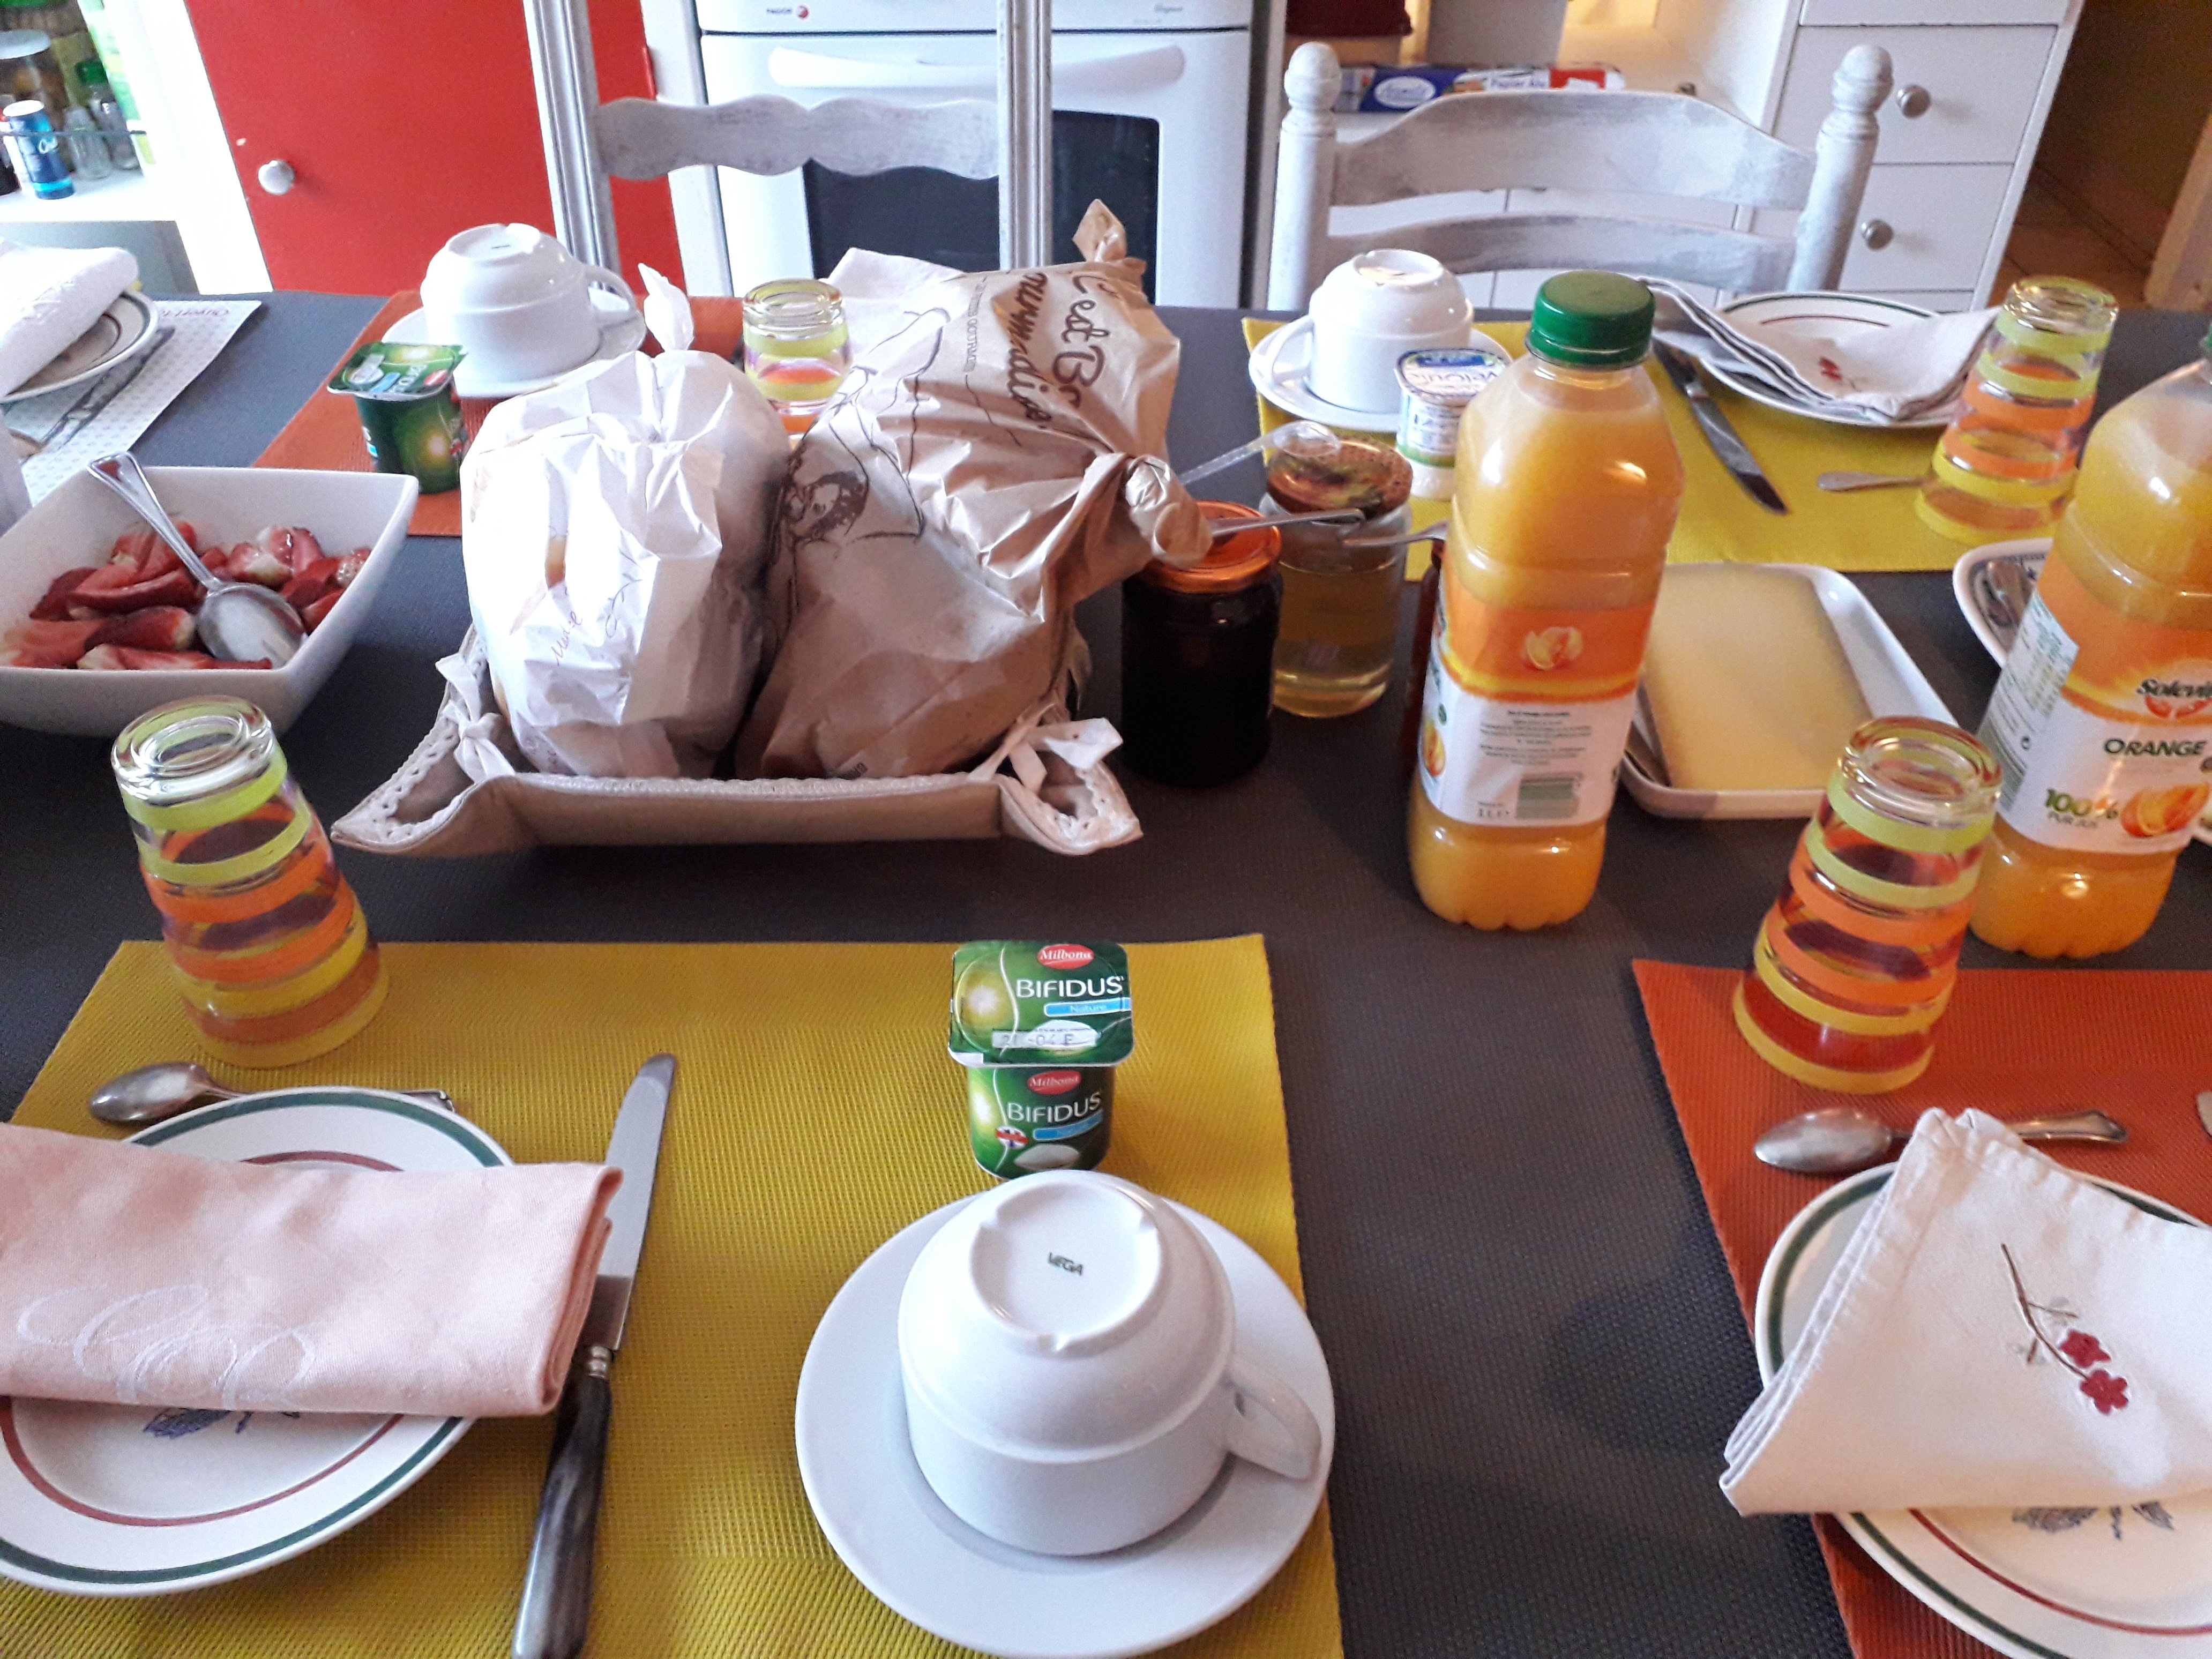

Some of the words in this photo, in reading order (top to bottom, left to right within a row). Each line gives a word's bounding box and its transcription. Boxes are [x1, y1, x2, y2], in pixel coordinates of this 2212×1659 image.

[2104, 738, 2207, 756] ORANGE
[1040, 950, 1092, 960] Milbona
[1016, 976, 1123, 998] BIFIDUS
[1030, 1076, 1079, 1087] Milbona
[1007, 1092, 1102, 1123] BIFIDUS
